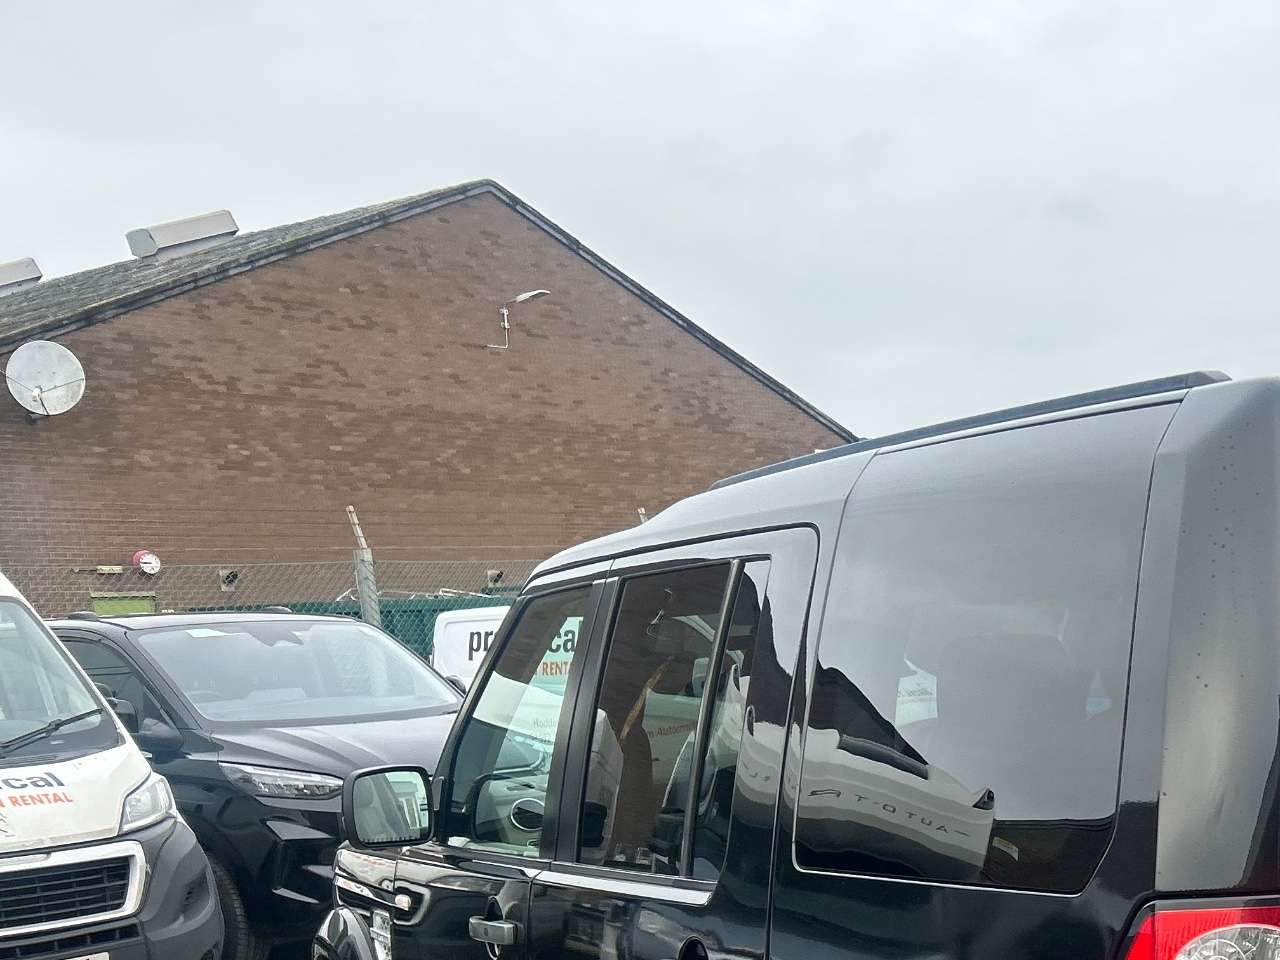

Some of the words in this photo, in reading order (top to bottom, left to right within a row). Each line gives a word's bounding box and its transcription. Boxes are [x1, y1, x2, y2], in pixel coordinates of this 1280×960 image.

[542, 661, 571, 676] RENT
[0, 772, 65, 789] cal
[8, 792, 74, 807] RENTAL
